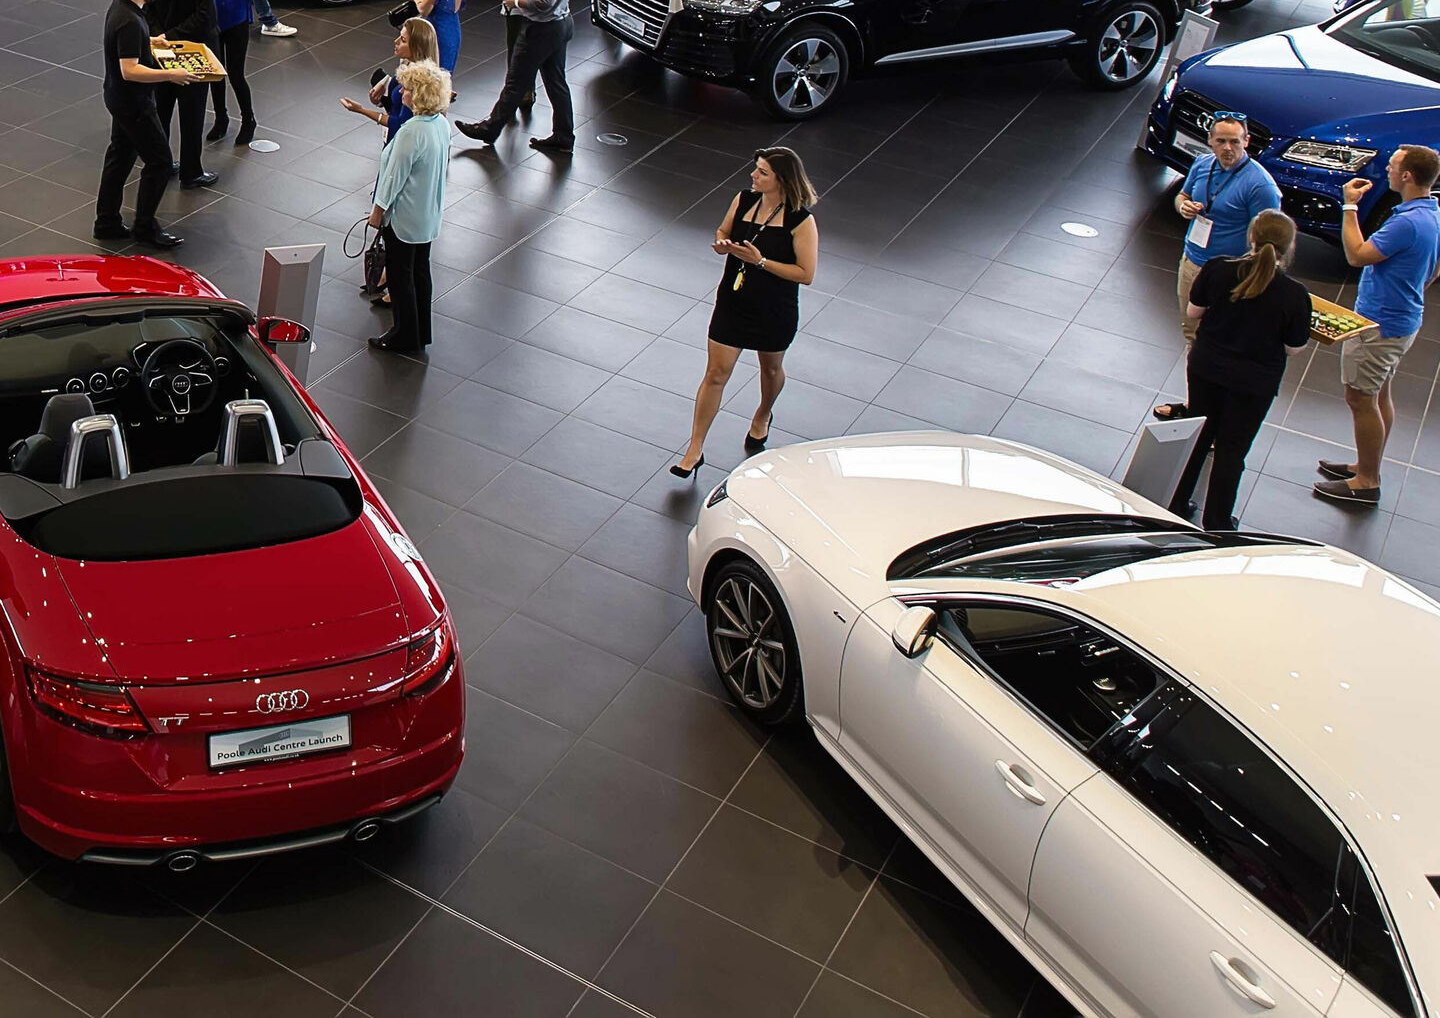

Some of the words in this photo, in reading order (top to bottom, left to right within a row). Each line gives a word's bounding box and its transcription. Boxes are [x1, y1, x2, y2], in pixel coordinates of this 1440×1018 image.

[158, 716, 190, 727] TT
[217, 749, 246, 761] Poole
[247, 745, 271, 756] Audi
[273, 740, 307, 752] Centre
[307, 733, 343, 746] Launch
